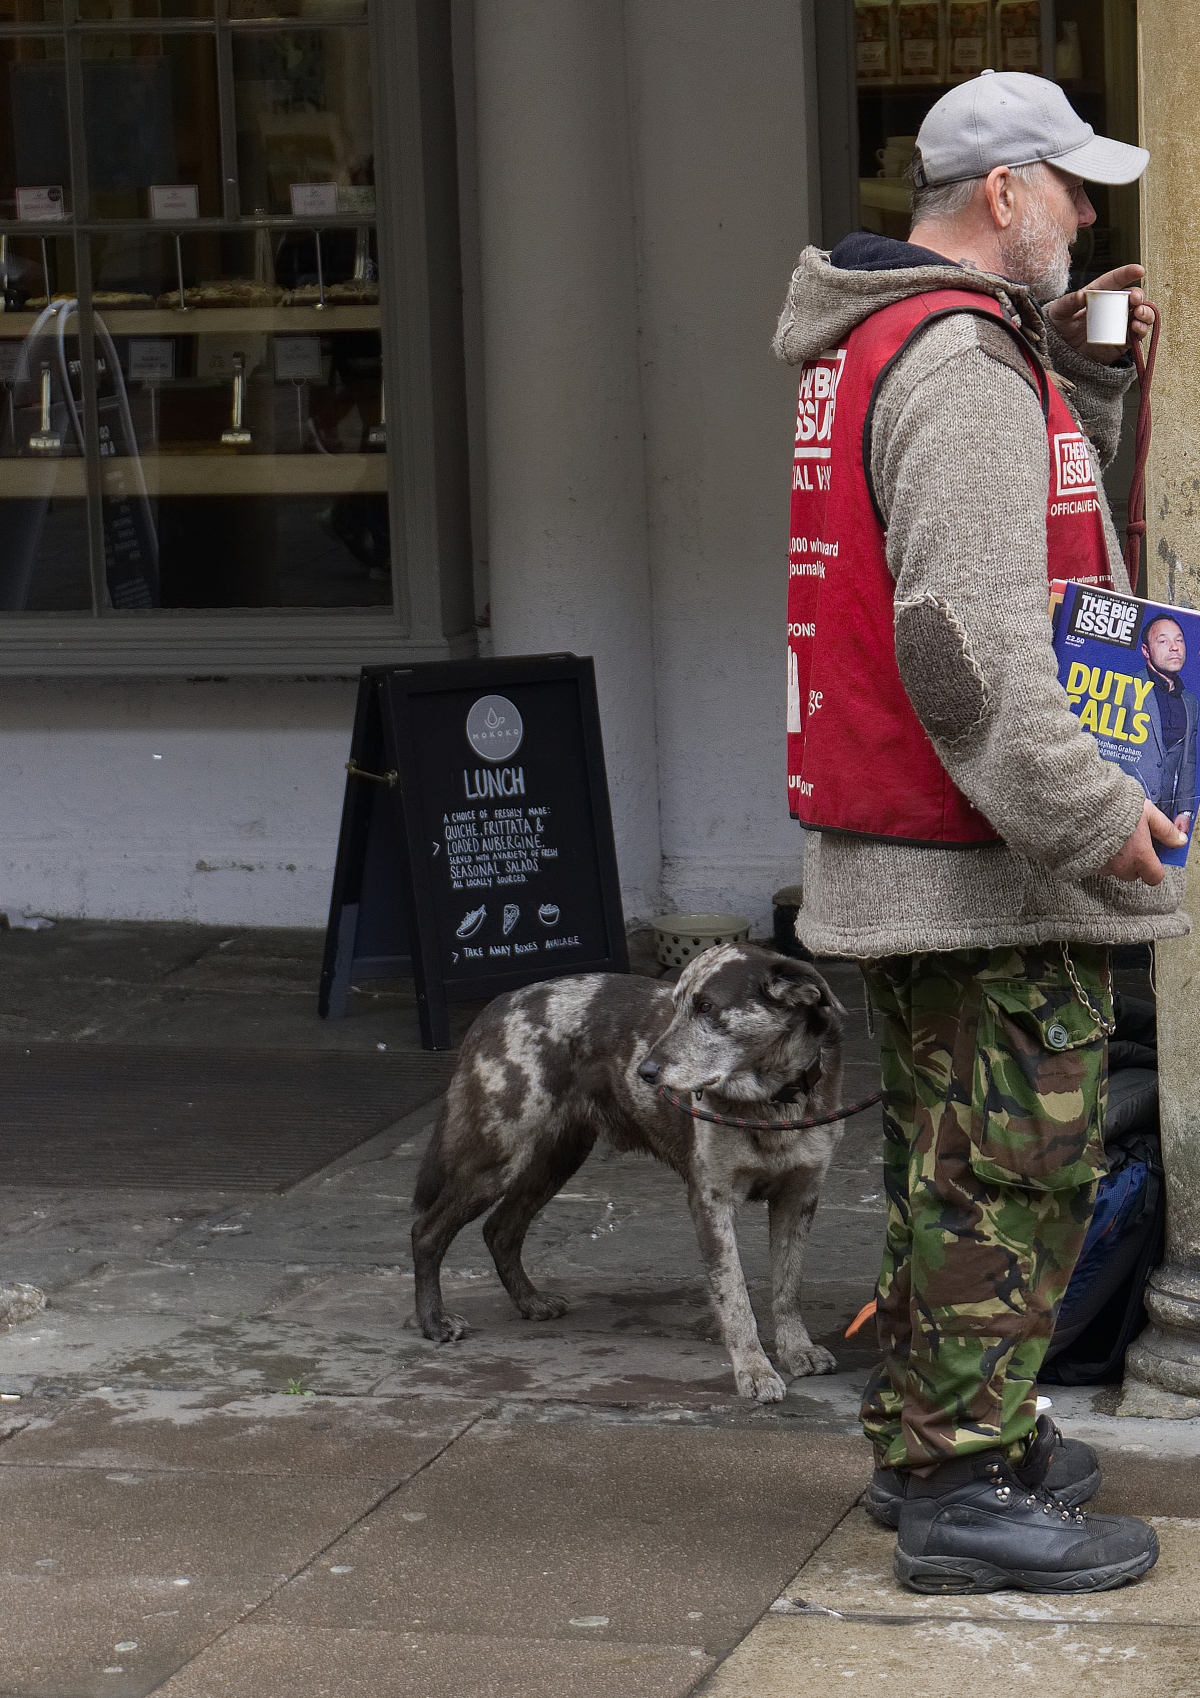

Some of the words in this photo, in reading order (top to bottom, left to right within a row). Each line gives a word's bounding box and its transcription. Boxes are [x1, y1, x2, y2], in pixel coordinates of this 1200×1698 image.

[1077, 575, 1098, 584] winning
[1081, 595, 1112, 617] THE
[1110, 602, 1138, 623] BIG
[1075, 609, 1136, 642] ISSUE
[1065, 634, 1086, 645] £2.50
[1066, 661, 1155, 711] DUTY
[1068, 694, 1151, 744] ALLS
[472, 728, 519, 740] MOKOKO
[1099, 747, 1122, 759] agnetic
[464, 766, 526, 799] LUNCH
[443, 813, 449, 824] A
[451, 810, 476, 822] CHOICE
[479, 809, 488, 819] OF
[494, 808, 522, 819] FRESHLY
[484, 818, 533, 836] FRITTATA
[536, 817, 545, 832] &
[447, 837, 480, 855] LOADED
[449, 856, 472, 865] SERVED
[450, 861, 501, 879] SEASONAL
[453, 880, 463, 888] ALL
[466, 877, 492, 887] LOCALLY
[463, 946, 484, 957] TAKE
[489, 944, 511, 957] AWAY
[514, 941, 538, 954] BOXES
